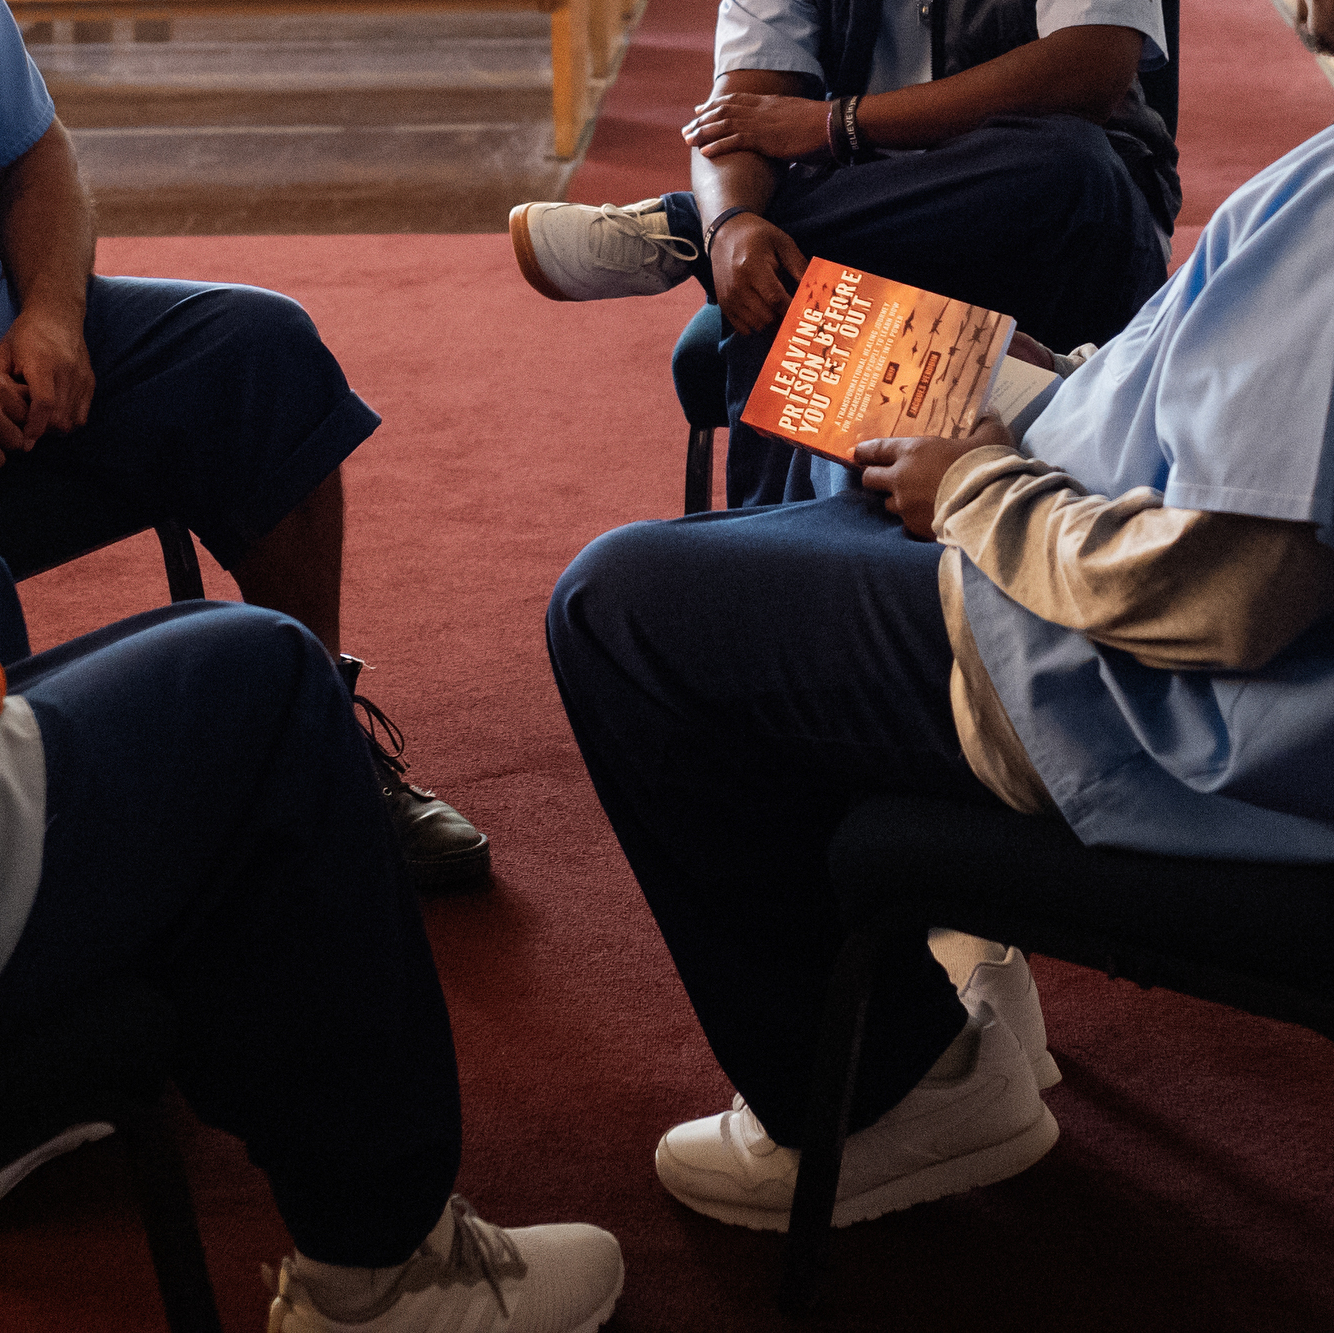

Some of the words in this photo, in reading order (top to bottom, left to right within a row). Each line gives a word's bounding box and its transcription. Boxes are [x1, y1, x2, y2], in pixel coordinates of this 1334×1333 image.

[769, 307, 824, 397] LEAVING
[778, 352, 825, 434] PRISON
[813, 270, 863, 347] BEFORE
[798, 392, 832, 435] YOU
[820, 344, 852, 386] GET
[839, 294, 873, 339] OUT
[841, 418, 851, 432] FOR
[866, 347, 881, 372] PEOPLE
[882, 337, 894, 355] INTO
